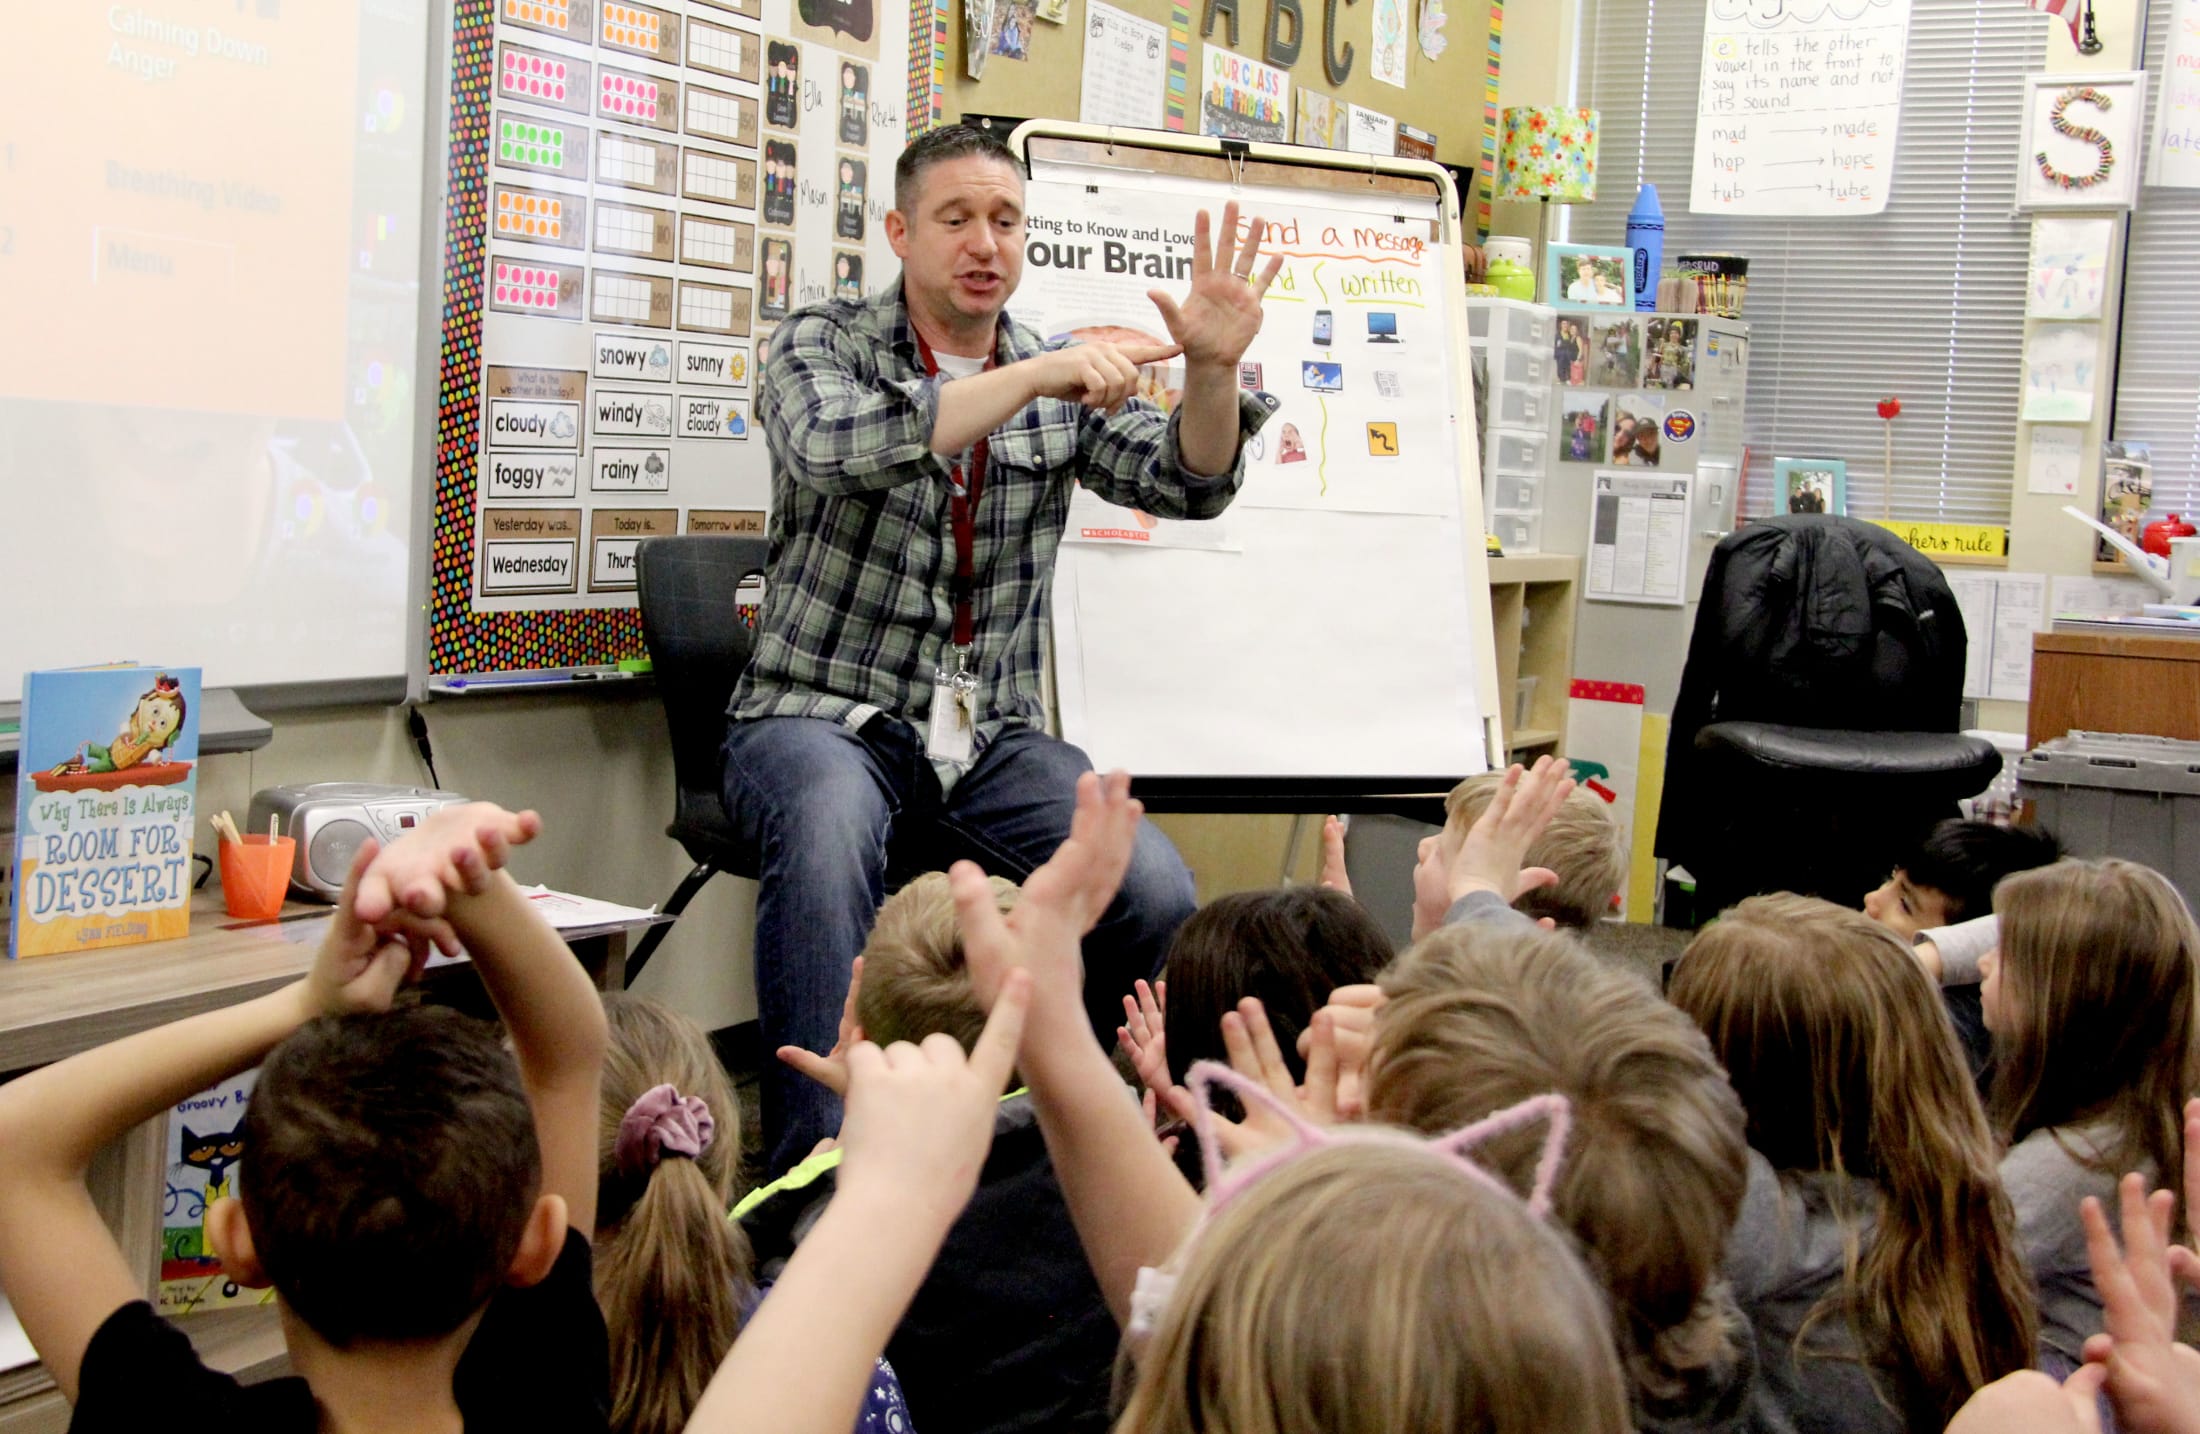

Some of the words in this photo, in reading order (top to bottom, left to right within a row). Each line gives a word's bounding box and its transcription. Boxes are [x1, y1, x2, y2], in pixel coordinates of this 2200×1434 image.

[108, 5, 200, 57] Calming
[207, 27, 269, 66] Down
[1718, 41, 1729, 57] e
[1746, 38, 1781, 57] tells
[1794, 36, 1820, 54] the
[1828, 32, 1879, 53] other
[107, 40, 177, 81] Anger
[1715, 58, 1753, 73] vowel
[1764, 59, 1780, 73] in
[1790, 57, 1814, 73] the
[1824, 53, 1866, 71] front
[1879, 53, 1894, 68] to
[1213, 52, 1240, 83] OUR
[1242, 63, 1280, 97] CLASS
[1712, 79, 1736, 99] say
[1745, 73, 1770, 90] its
[1779, 75, 1820, 90] name
[1830, 72, 1860, 87] and
[1871, 69, 1896, 84] not
[804, 78, 823, 112] Ella
[1211, 80, 1280, 124] BIRTHDAYS
[1712, 93, 1736, 110] its
[1743, 92, 1791, 110] sound
[1355, 109, 1389, 127] JANUARY
[1712, 125, 1747, 142] mad
[1832, 119, 1878, 137] made
[2035, 86, 2116, 189] S
[1712, 151, 1746, 173] hop
[1832, 148, 1875, 168] hope
[105, 158, 216, 211] Breathing
[220, 178, 281, 215] Video
[801, 180, 829, 210] Mason
[1711, 181, 1746, 201] tub
[1825, 179, 1871, 198] tube
[1027, 216, 1064, 236] tting
[1067, 218, 1084, 234] to
[1086, 220, 1129, 239] Know
[1132, 227, 1160, 242] and
[1163, 229, 1197, 246] Love
[1235, 216, 1300, 246] Snd
[1322, 226, 1344, 248] a
[107, 240, 176, 280] Menu
[1025, 232, 1094, 271] our
[1103, 240, 1194, 281] Brain
[1340, 268, 1422, 297] written
[599, 346, 647, 372] snowy
[686, 353, 725, 378] sunny
[1240, 362, 1257, 372] FIRE
[500, 385, 534, 397] weather
[516, 372, 538, 385] What
[598, 401, 644, 429] windy
[688, 400, 721, 420] partly
[495, 412, 547, 439] cloudy
[686, 416, 722, 436] cloudy
[495, 462, 545, 489] foggy
[601, 458, 640, 485] rainy
[493, 517, 545, 535] Yesterday
[613, 516, 642, 534] Today
[690, 517, 732, 533] Tomorrow
[733, 517, 747, 532] will
[1090, 529, 1150, 541] SCHOLASTIC
[1903, 527, 1950, 551] hers
[1954, 530, 1993, 553] rule
[491, 554, 569, 576] Wednesday
[607, 552, 637, 571] Thurs
[40, 800, 71, 832] Why
[77, 798, 119, 820] There
[122, 796, 137, 816] Is
[141, 791, 190, 823] Always
[45, 827, 120, 866] ROOM
[128, 823, 181, 858] FOR
[34, 855, 186, 915] DESSERT
